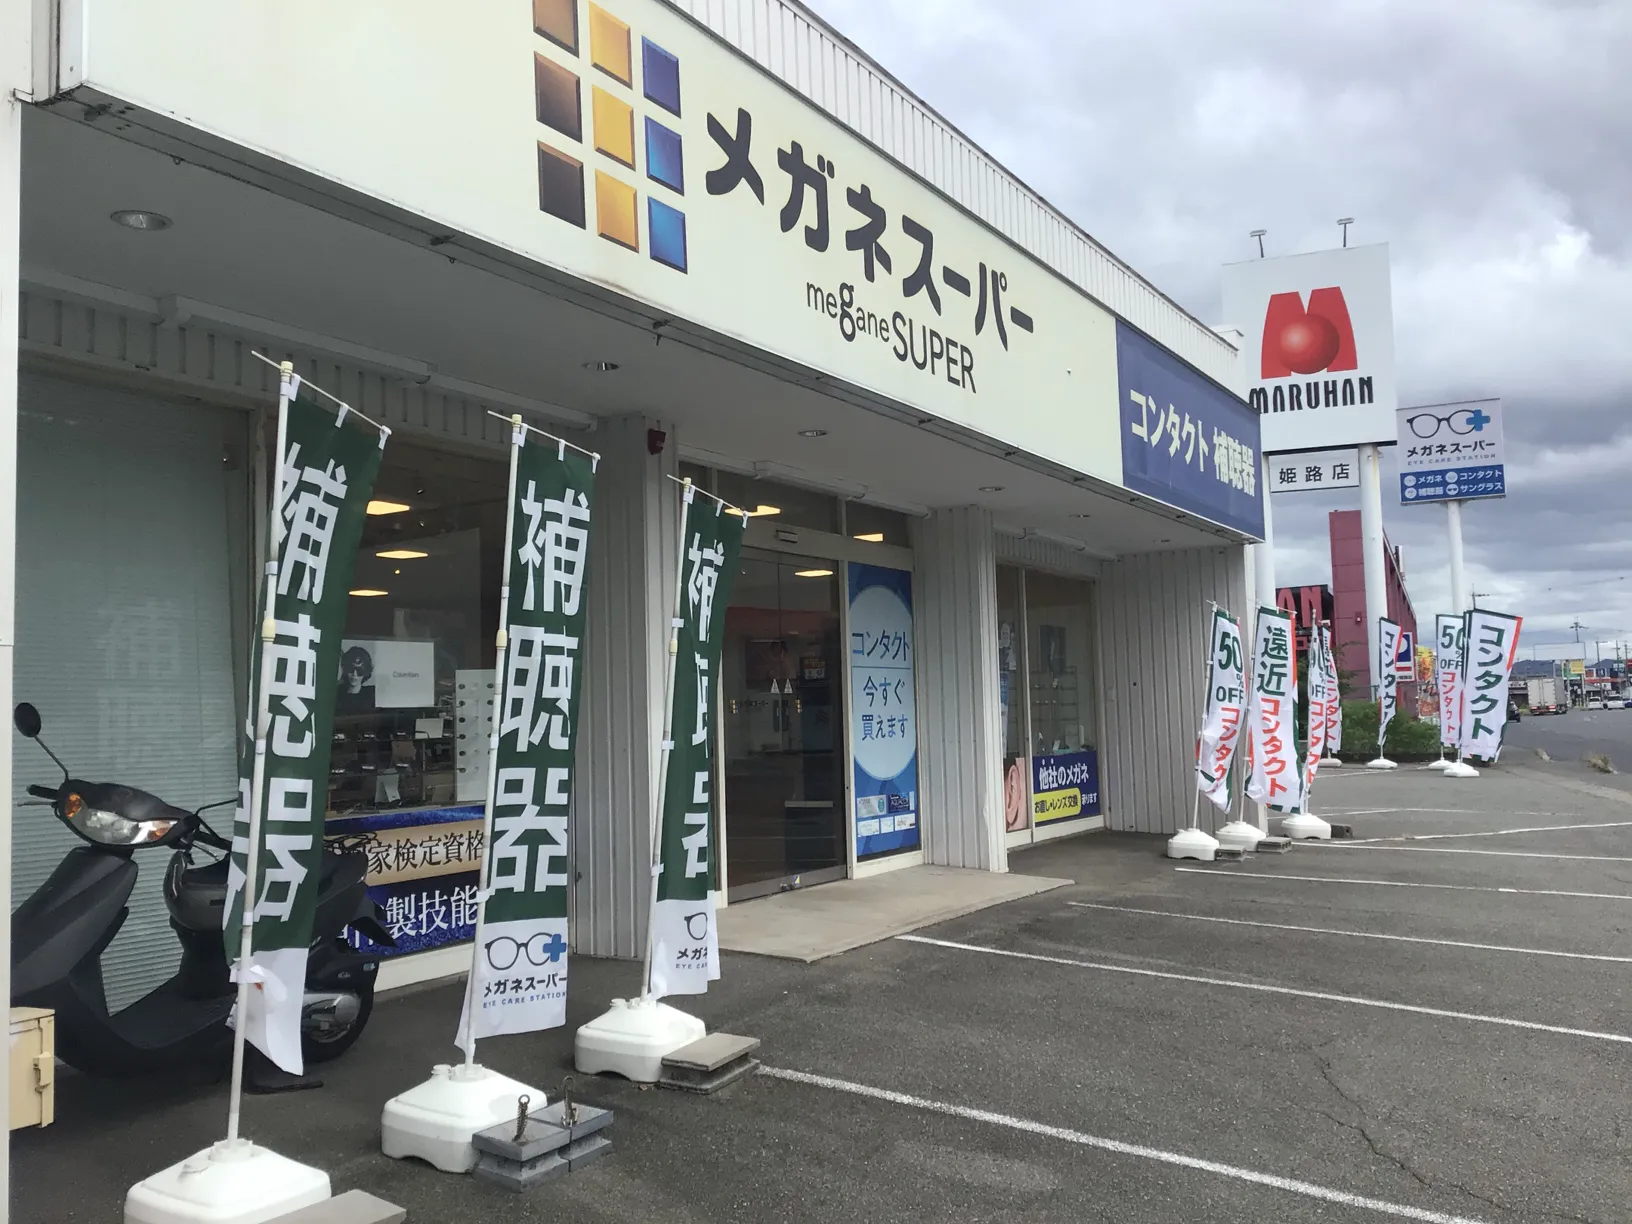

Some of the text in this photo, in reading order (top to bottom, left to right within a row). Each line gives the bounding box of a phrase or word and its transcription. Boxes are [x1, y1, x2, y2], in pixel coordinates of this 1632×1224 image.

[706, 107, 1033, 351] メガネスーパー
[1249, 376, 1374, 414] MARUHAN
[1130, 389, 1256, 497] コンタクト 補聴器
[1407, 440, 1496, 458] メガネスーパー
[1456, 453, 1496, 461] STATION
[1279, 463, 1350, 484] 姫路店
[1418, 475, 1443, 484] メガネ
[1460, 470, 1502, 480] コンタクト
[1460, 482, 1503, 493] サングラス
[852, 629, 910, 661] コンタクト
[1440, 659, 1463, 670] OFF
[486, 481, 590, 897] 補聴器
[863, 676, 905, 707] 今すぐ
[1216, 686, 1244, 704] OFF
[1470, 624, 1505, 740] コンタクト
[1442, 672, 1456, 733] コンタクト
[862, 714, 908, 740] 買えます
[1214, 707, 1240, 782] コンタク
[1039, 762, 1089, 790] 他社のメガネ
[367, 829, 484, 874] 家検定資格
[484, 973, 567, 998] メガネスーパー
[502, 997, 525, 1006] CARE
